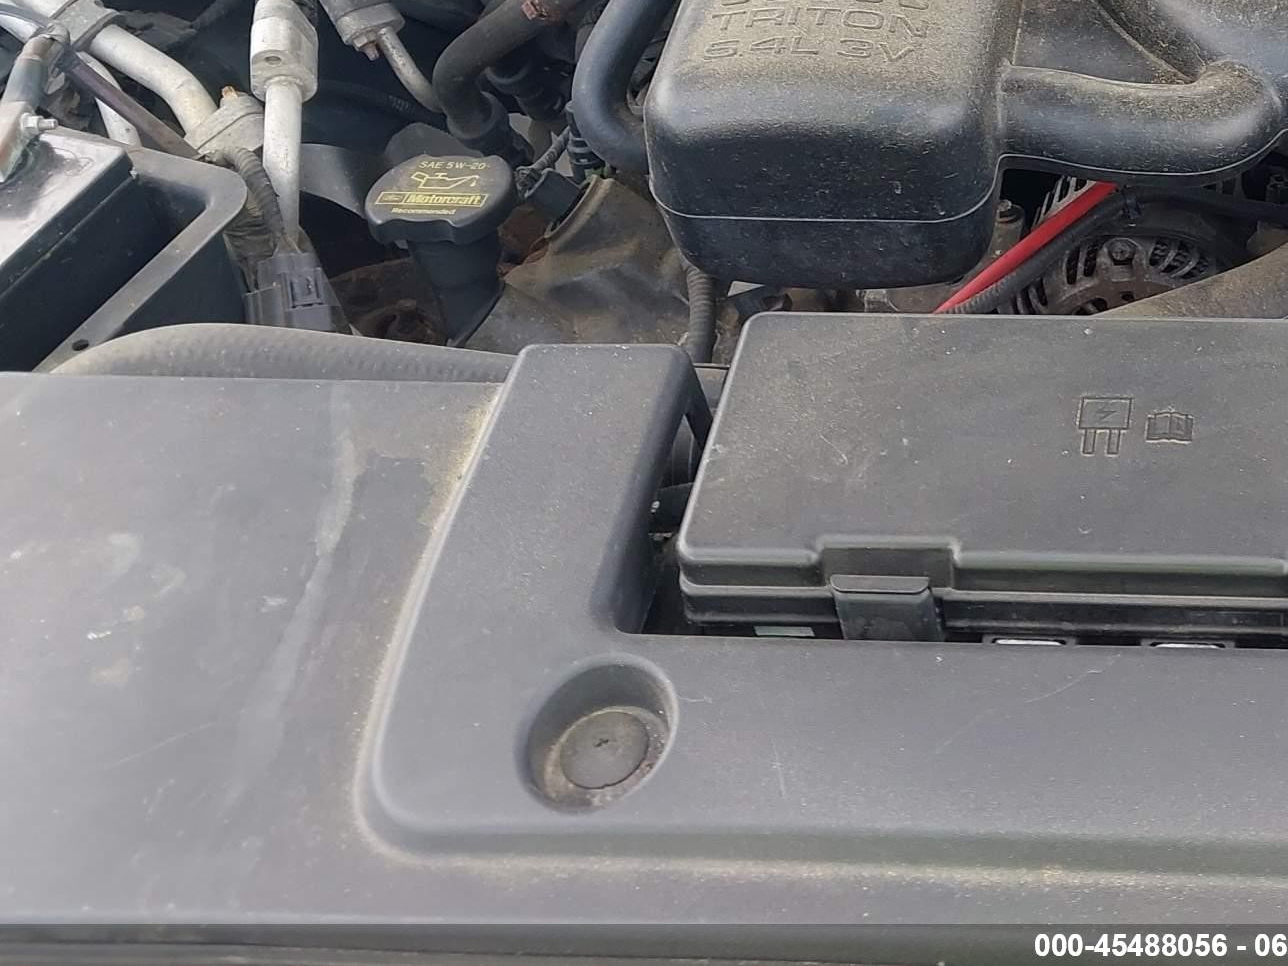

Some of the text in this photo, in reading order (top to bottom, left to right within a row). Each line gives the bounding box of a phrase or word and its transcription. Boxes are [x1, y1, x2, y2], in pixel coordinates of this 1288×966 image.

[711, 7, 934, 40] TRITON
[704, 36, 920, 63] 5.4L 3V
[418, 161, 487, 170] SAE 5W-20
[408, 193, 482, 205] Motorcraft
